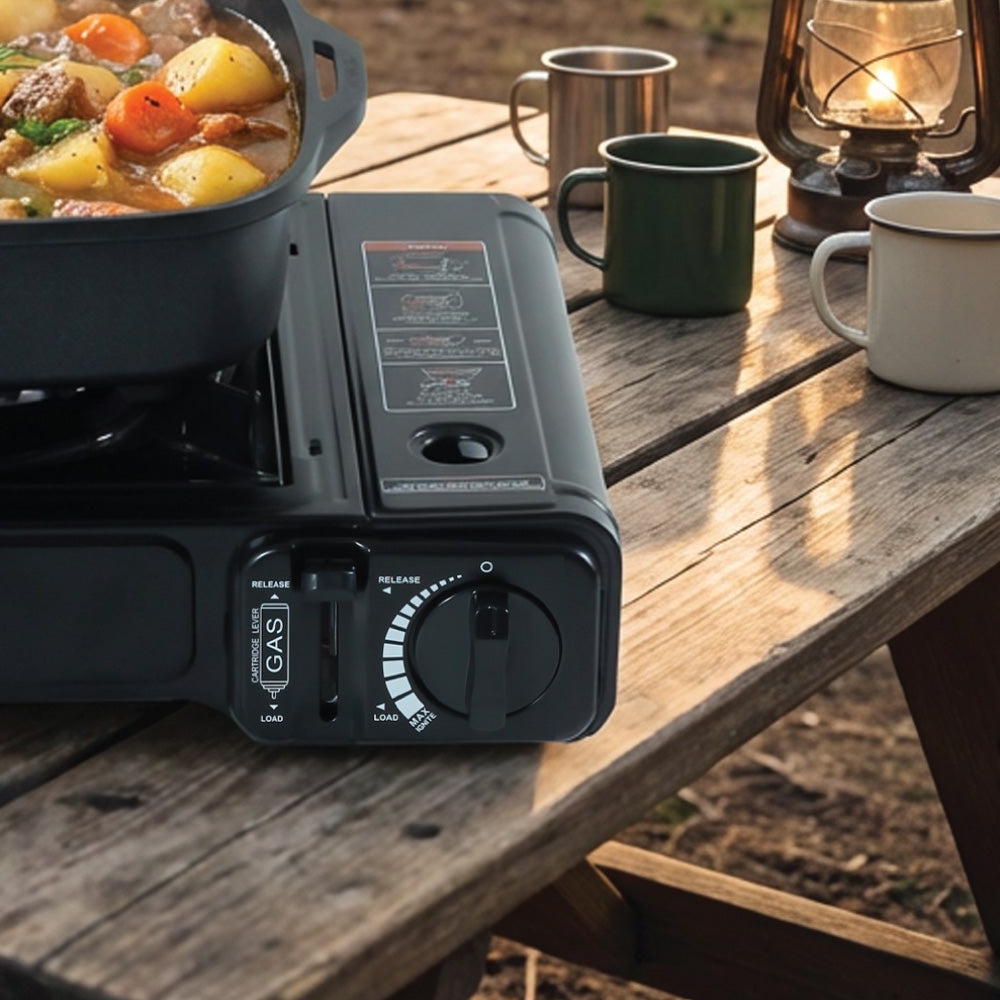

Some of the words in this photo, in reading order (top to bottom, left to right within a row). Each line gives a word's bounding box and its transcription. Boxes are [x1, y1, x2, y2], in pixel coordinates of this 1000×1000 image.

[251, 580, 290, 588] RELEASE
[378, 576, 421, 584] RELEASE
[251, 608, 260, 634] LEVER
[266, 618, 283, 673] GAS
[251, 638, 260, 683] CARTRIDGE
[409, 707, 430, 727] MAX
[415, 712, 437, 732] IGNITE
